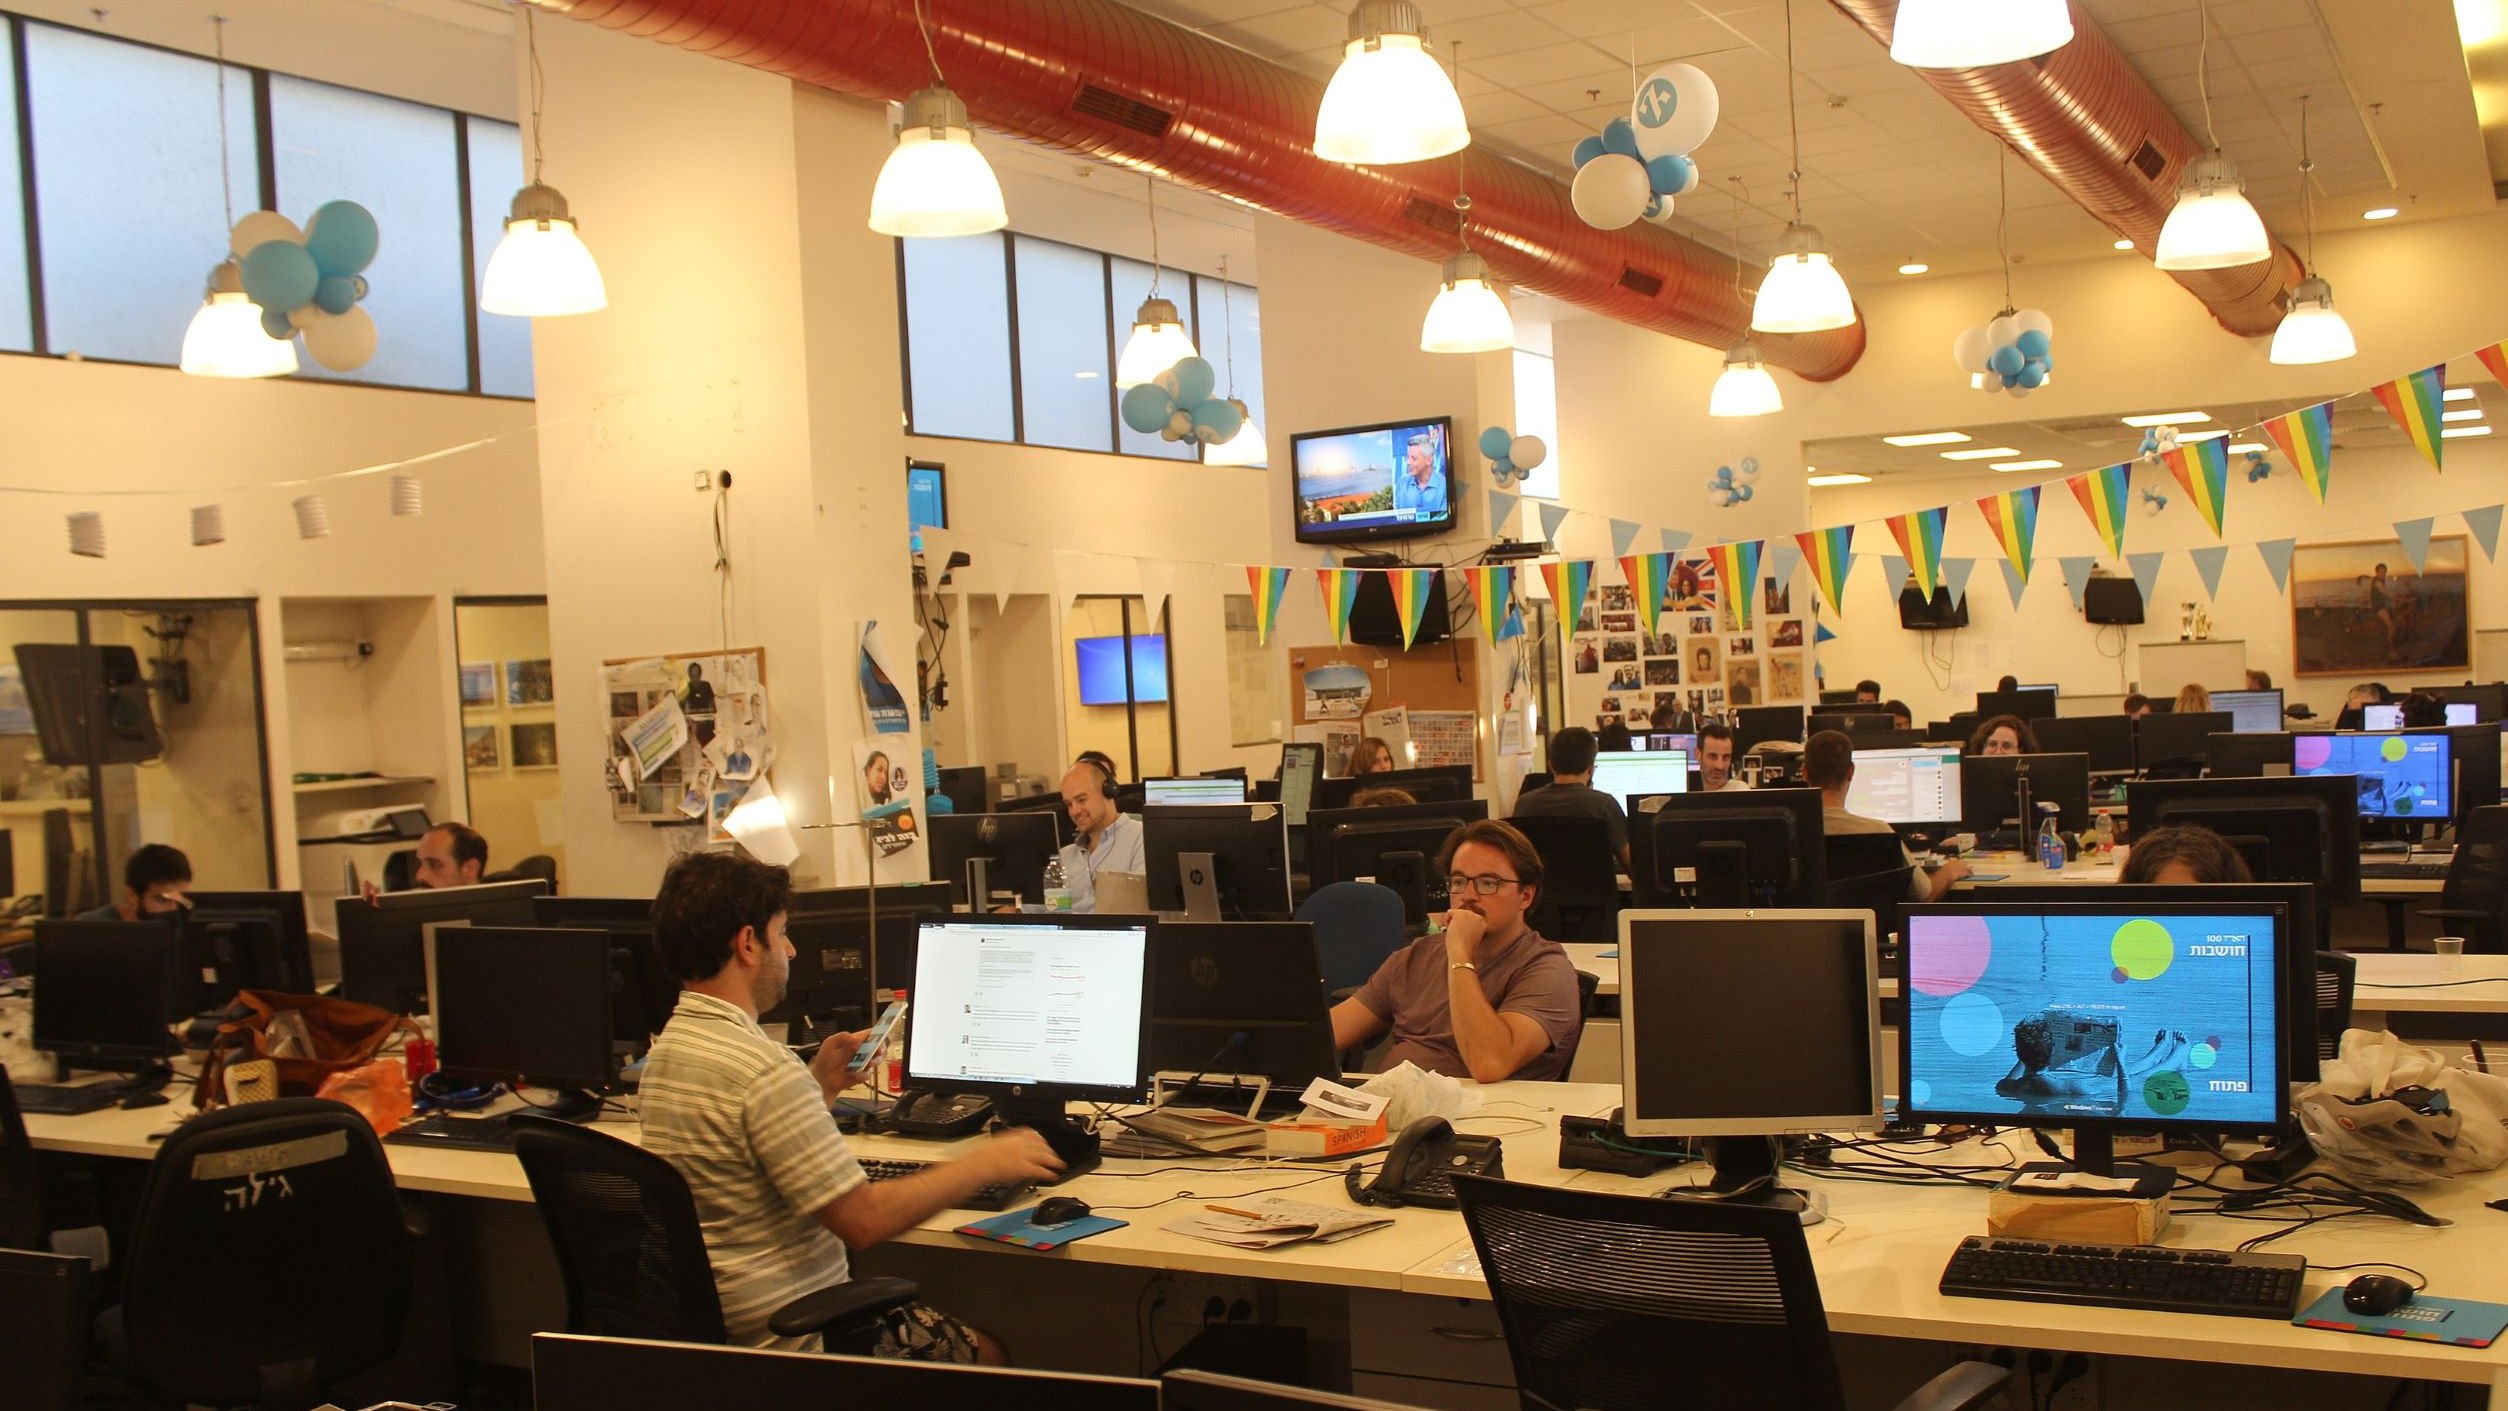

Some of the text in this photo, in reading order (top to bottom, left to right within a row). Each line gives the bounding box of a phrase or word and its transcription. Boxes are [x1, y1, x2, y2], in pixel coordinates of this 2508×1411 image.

[1638, 83, 1671, 123] א
[2206, 935, 2223, 943] 100
[2190, 945, 2246, 957] חושבות
[2208, 1080, 2247, 1092] פתוח
[1332, 1127, 1367, 1147] SPANISH
[223, 1172, 294, 1212] גילה
